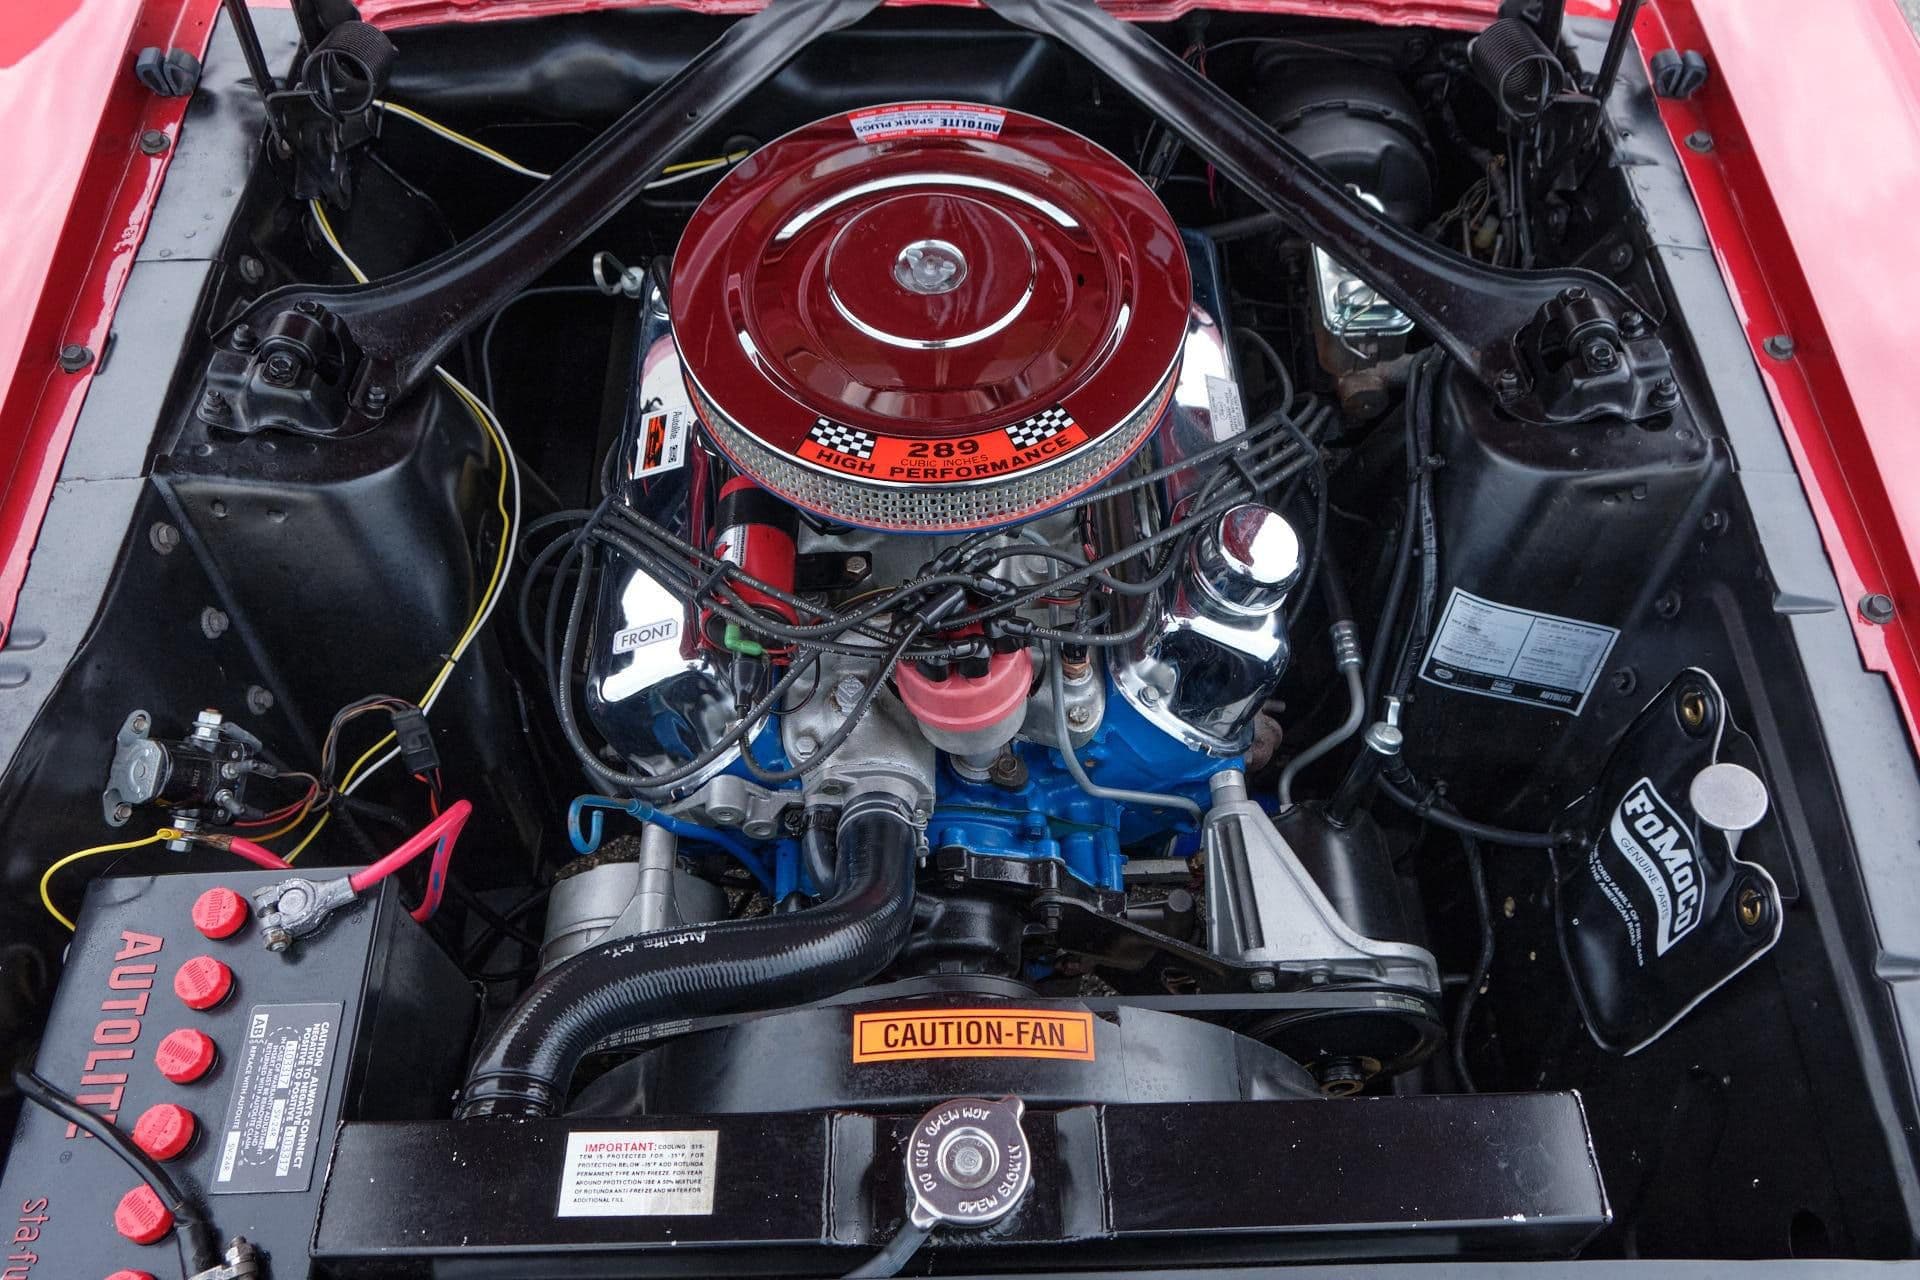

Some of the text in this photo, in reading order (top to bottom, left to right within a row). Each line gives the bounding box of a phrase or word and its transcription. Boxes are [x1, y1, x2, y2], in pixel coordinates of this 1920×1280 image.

[856, 118, 1000, 133] AUTOLITE SPARK PLUGS
[670, 411, 682, 440] Autolite
[815, 435, 1072, 479] HIGH PERFORMANCE
[900, 454, 989, 468] CUBIC INCHES
[907, 439, 980, 459] 289
[792, 599, 821, 614] AUTOLITE
[621, 622, 672, 647] FRONT
[1624, 789, 1699, 933] FoMoCo
[1595, 859, 1611, 883] FORD
[1609, 881, 1633, 910] FAMILY
[1620, 837, 1670, 921] GENUINE PARTS
[1590, 864, 1601, 882] THE
[1598, 881, 1629, 922] AMERICAN
[1626, 921, 1636, 947] ROAD
[644, 930, 707, 949] Autolite
[251, 1018, 265, 1036] AB
[884, 1020, 1065, 1048] CAUTION-FAN
[260, 1042, 272, 1075] RETURNED
[268, 1045, 277, 1066] INSERT
[313, 1022, 329, 1066] CAUTION
[245, 1046, 257, 1074] REPLACE
[285, 1027, 311, 1121] POSITIVE TO POSITIVE
[292, 1023, 319, 1125] NEGATIVE TO NEGATIVE
[240, 1076, 250, 1095] WITH
[265, 1073, 278, 1109] WARRANTY
[303, 1076, 318, 1116] ALWAYS
[232, 1095, 245, 1128] AUTOLITE
[248, 1095, 261, 1126] AUTOLITE
[254, 1097, 266, 1129] REMOVED
[255, 1111, 270, 1155] ADJUSTMENT
[292, 1118, 310, 1168] CONNECT
[585, 1142, 657, 1153] IMPORTANT:
[915, 1139, 930, 1168] NOT
[919, 1173, 937, 1192] DO
[958, 1195, 998, 1213] OPEN
[998, 1144, 1022, 1198] SLOWLY
